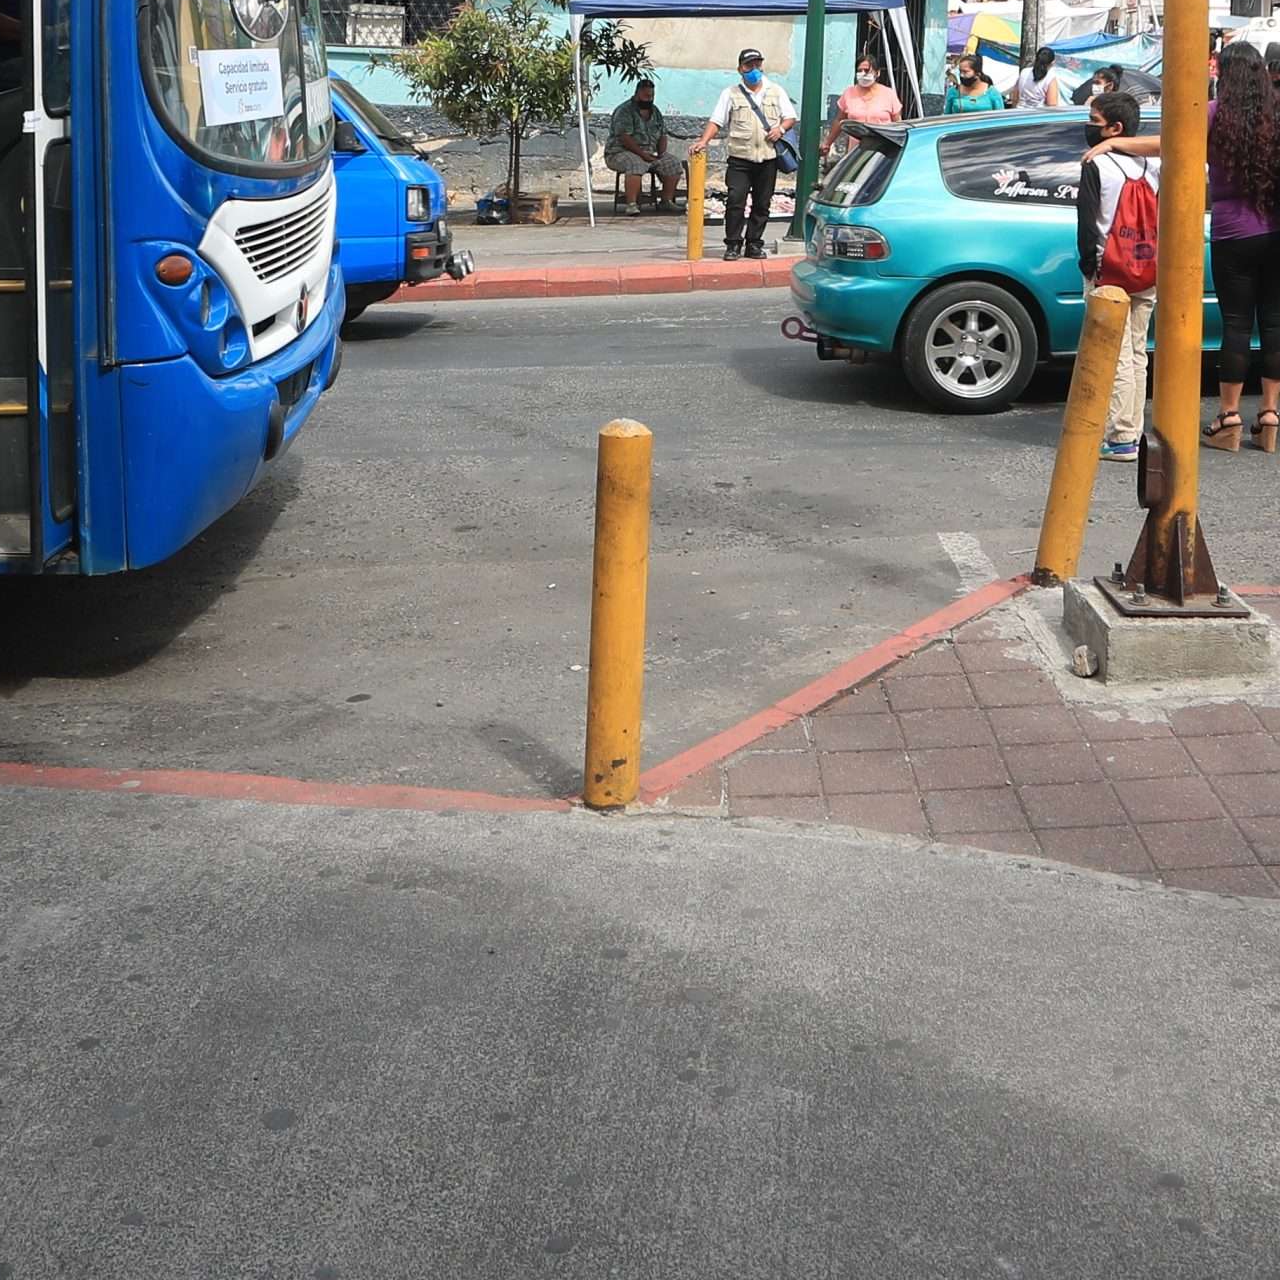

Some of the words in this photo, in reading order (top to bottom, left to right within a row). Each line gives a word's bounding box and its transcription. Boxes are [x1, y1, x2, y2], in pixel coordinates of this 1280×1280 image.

[218, 61, 248, 76] Capacidad
[225, 81, 247, 94] Servicio
[994, 180, 1049, 198] Jefferson
